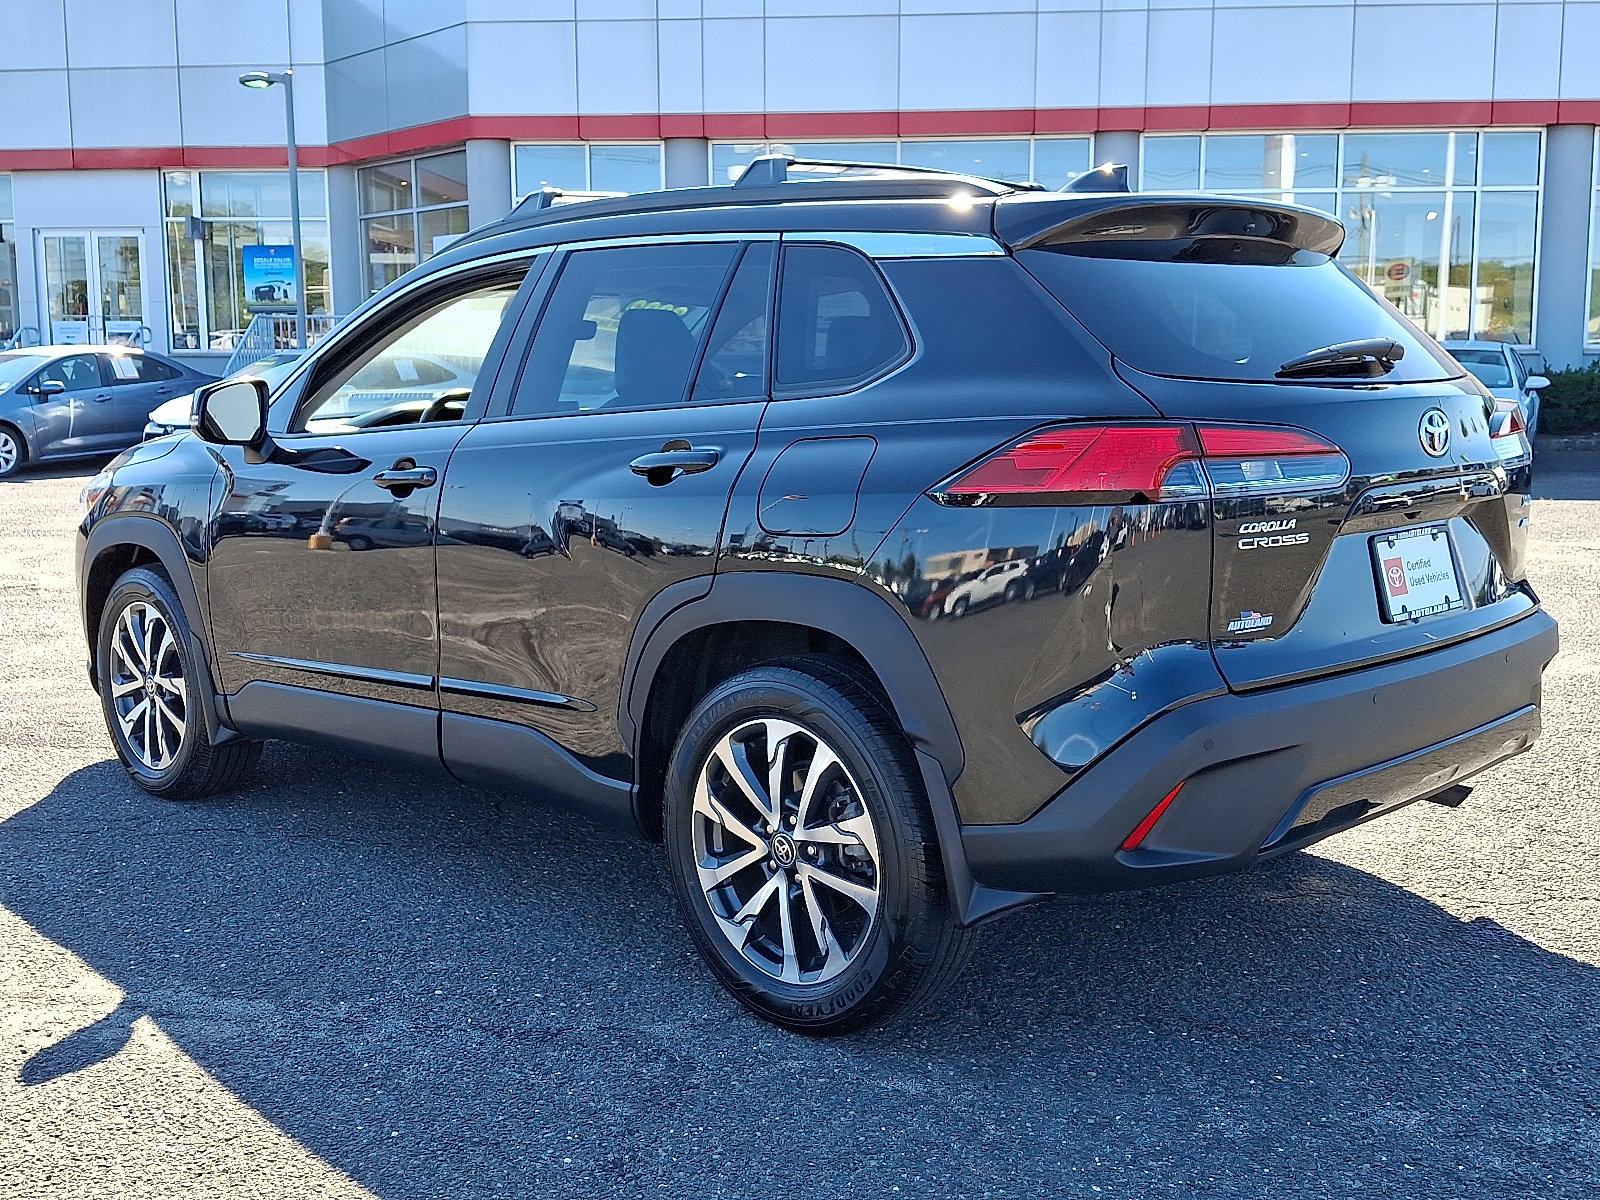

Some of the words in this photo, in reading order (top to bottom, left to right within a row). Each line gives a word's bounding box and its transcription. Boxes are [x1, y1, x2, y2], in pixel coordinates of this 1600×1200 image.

[1239, 519, 1297, 533] COROLLA
[1238, 533, 1309, 549] CROSS
[1406, 558, 1432, 571] Certified
[1409, 576, 1425, 587] Used
[1425, 571, 1450, 584] Vehicles
[1410, 603, 1449, 619] AUTOLAND
[1227, 616, 1273, 632] AUTOLAND
